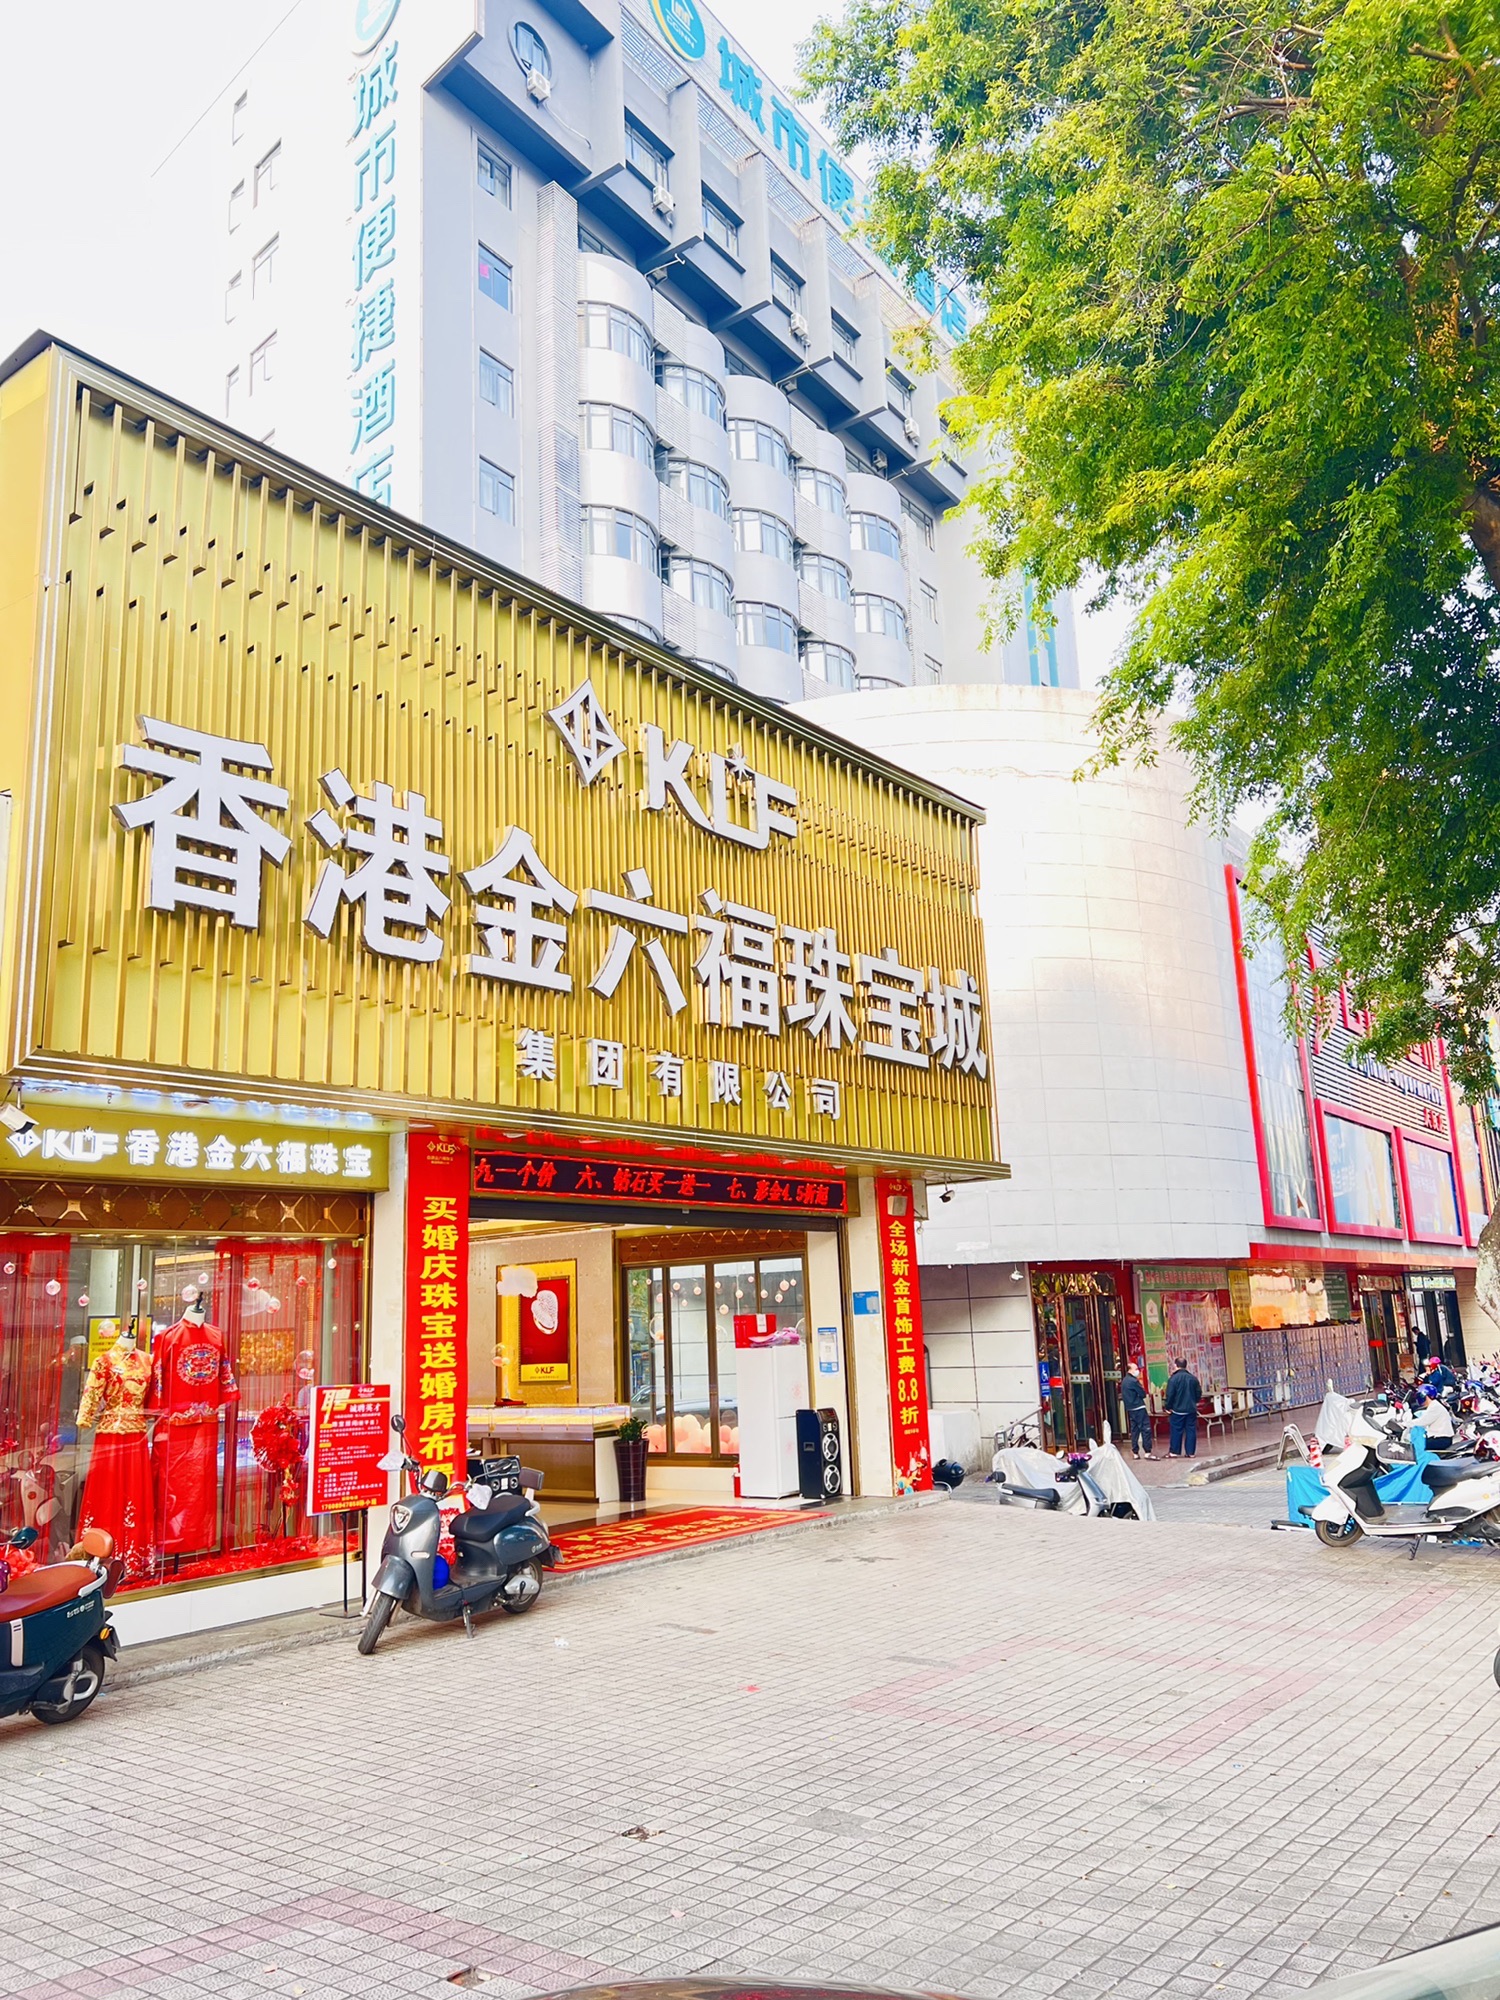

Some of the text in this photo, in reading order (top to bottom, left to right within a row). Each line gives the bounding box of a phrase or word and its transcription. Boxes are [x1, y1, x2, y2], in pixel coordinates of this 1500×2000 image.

[351, 40, 399, 508] 城市便捷酒店
[642, 723, 798, 850] KLF
[111, 714, 987, 1079] 香港金六福珠宝城
[516, 1027, 841, 1121] 集团有限公司
[125, 1129, 372, 1178] 香港金六福珠宝
[321, 1388, 351, 1424] 聘
